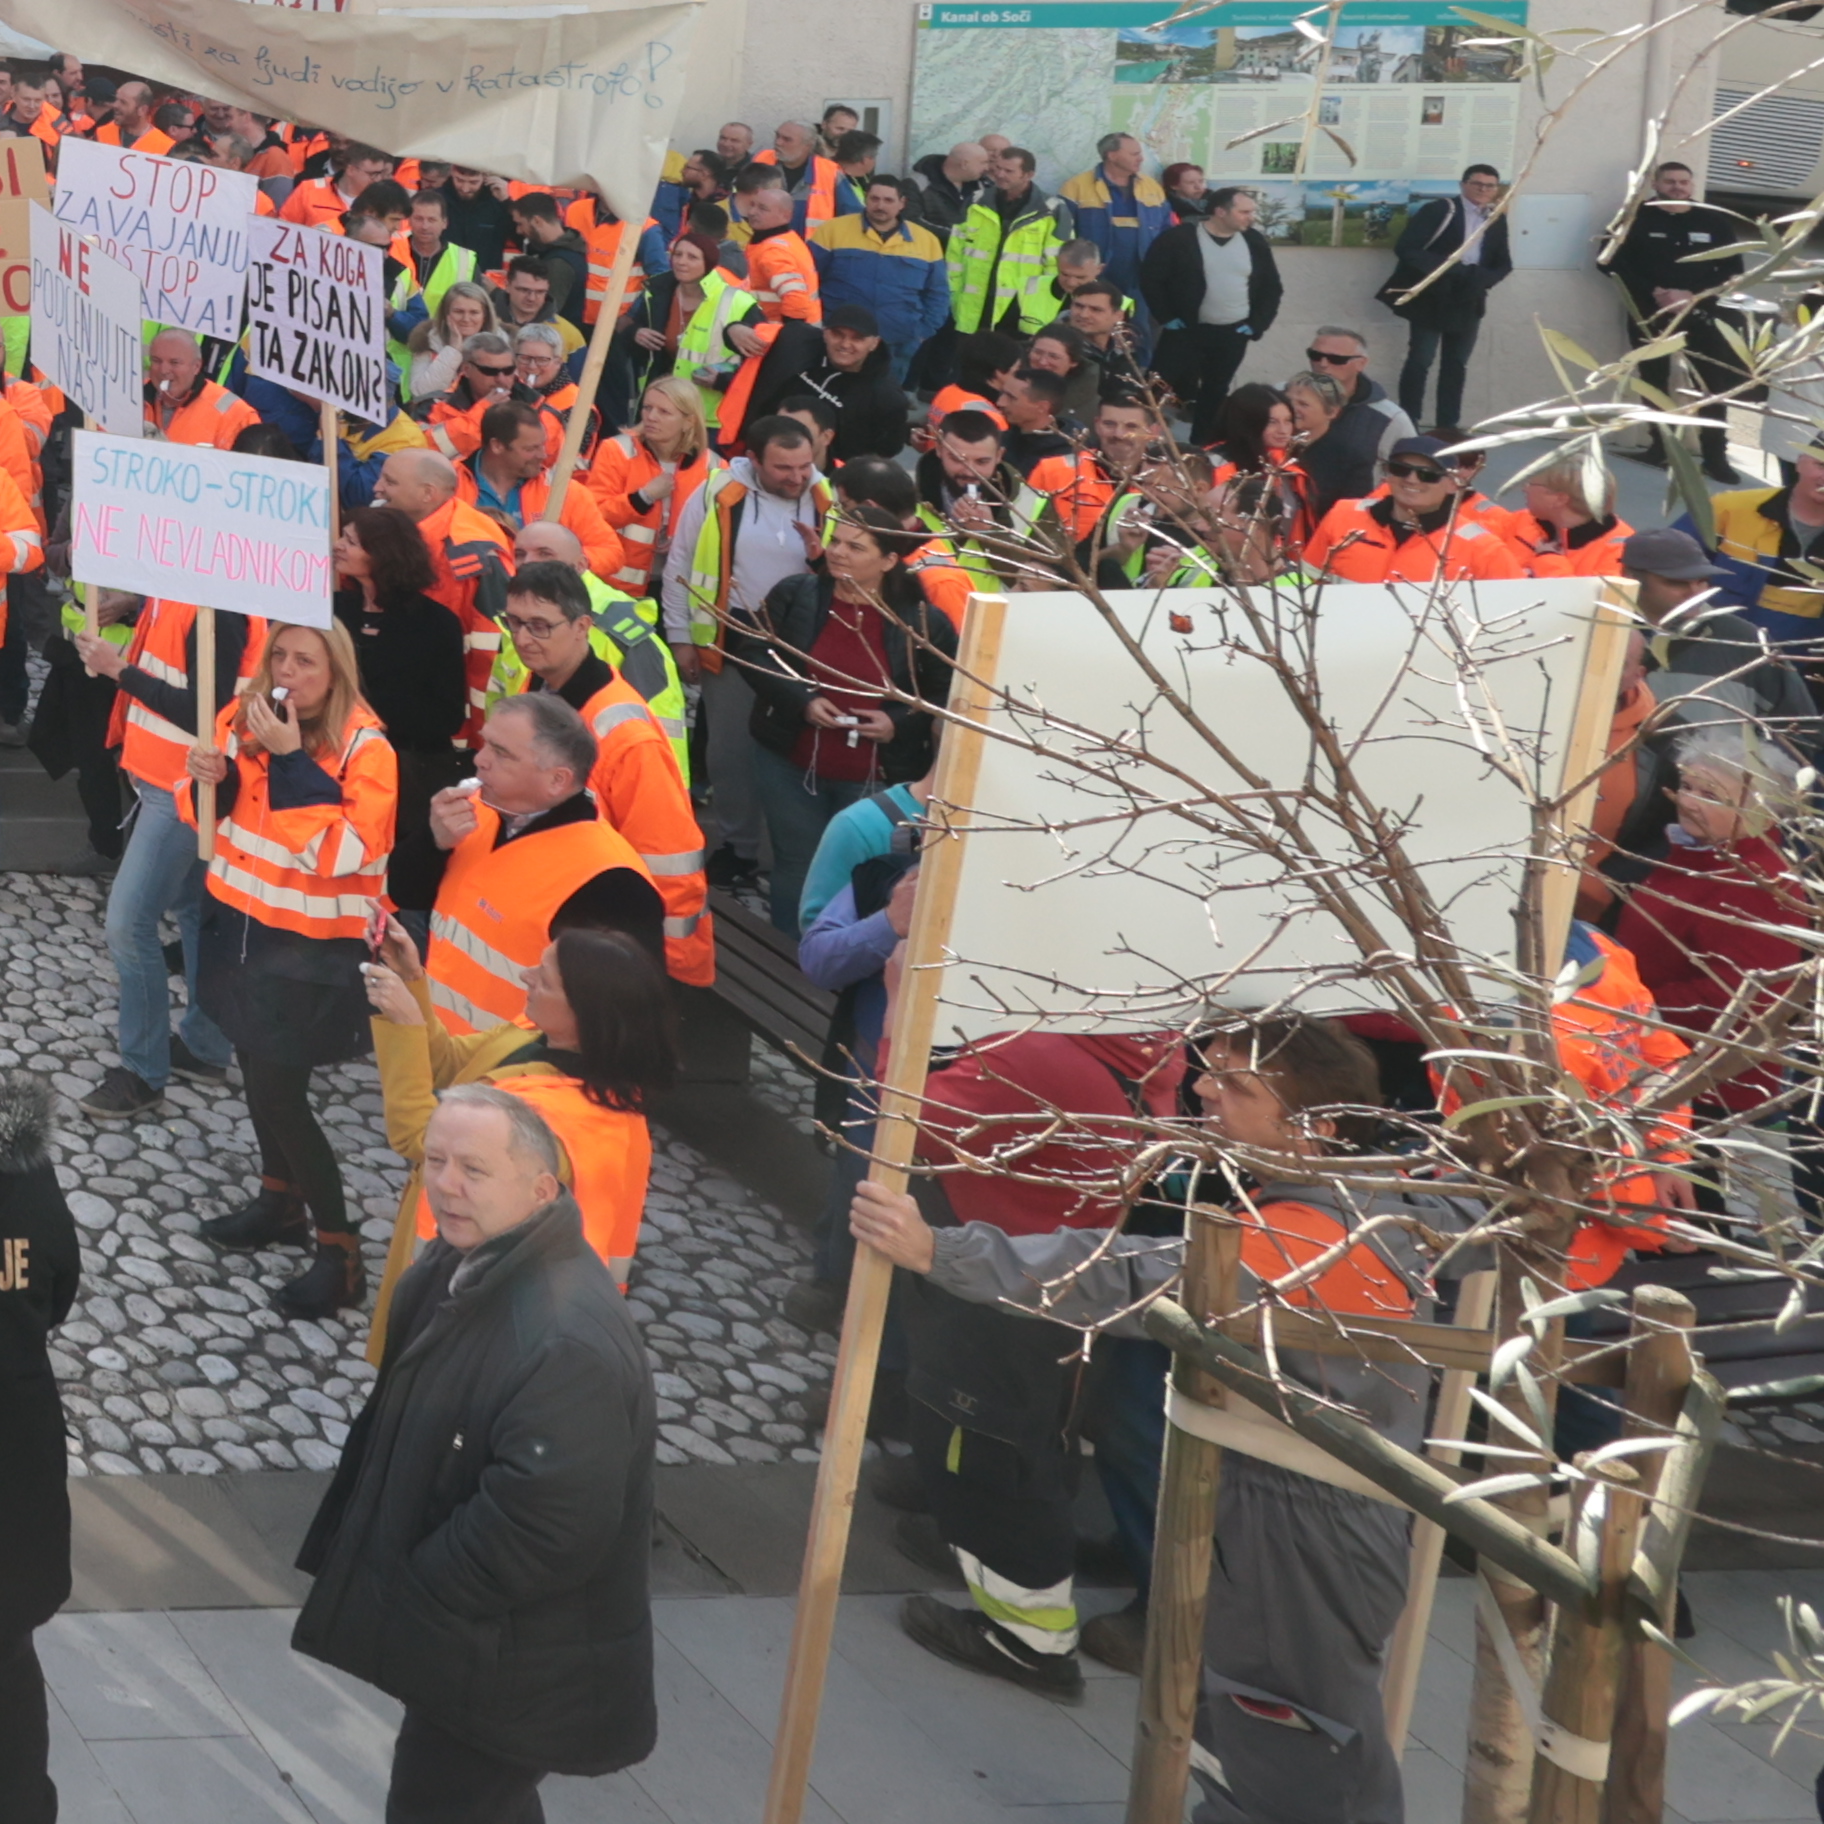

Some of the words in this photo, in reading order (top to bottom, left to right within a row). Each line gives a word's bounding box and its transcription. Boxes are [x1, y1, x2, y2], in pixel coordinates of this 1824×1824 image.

[940, 10, 980, 23] Kanal
[981, 10, 1000, 23] ob
[1001, 9, 1032, 23] Soči
[253, 45, 322, 86] ljudi
[331, 65, 424, 109] vodijo
[109, 154, 217, 220] STOP
[54, 189, 250, 274] ZAVAJANJU
[58, 227, 91, 297] NE
[269, 225, 308, 269] ZA
[319, 235, 368, 292] KOGA
[32, 258, 138, 407] PODCENJUJTE
[250, 261, 276, 313] JE
[288, 268, 372, 346] PISAN
[254, 320, 286, 375] TA
[72, 502, 124, 558] NE
[137, 512, 331, 599] NEVLADNIKOM
